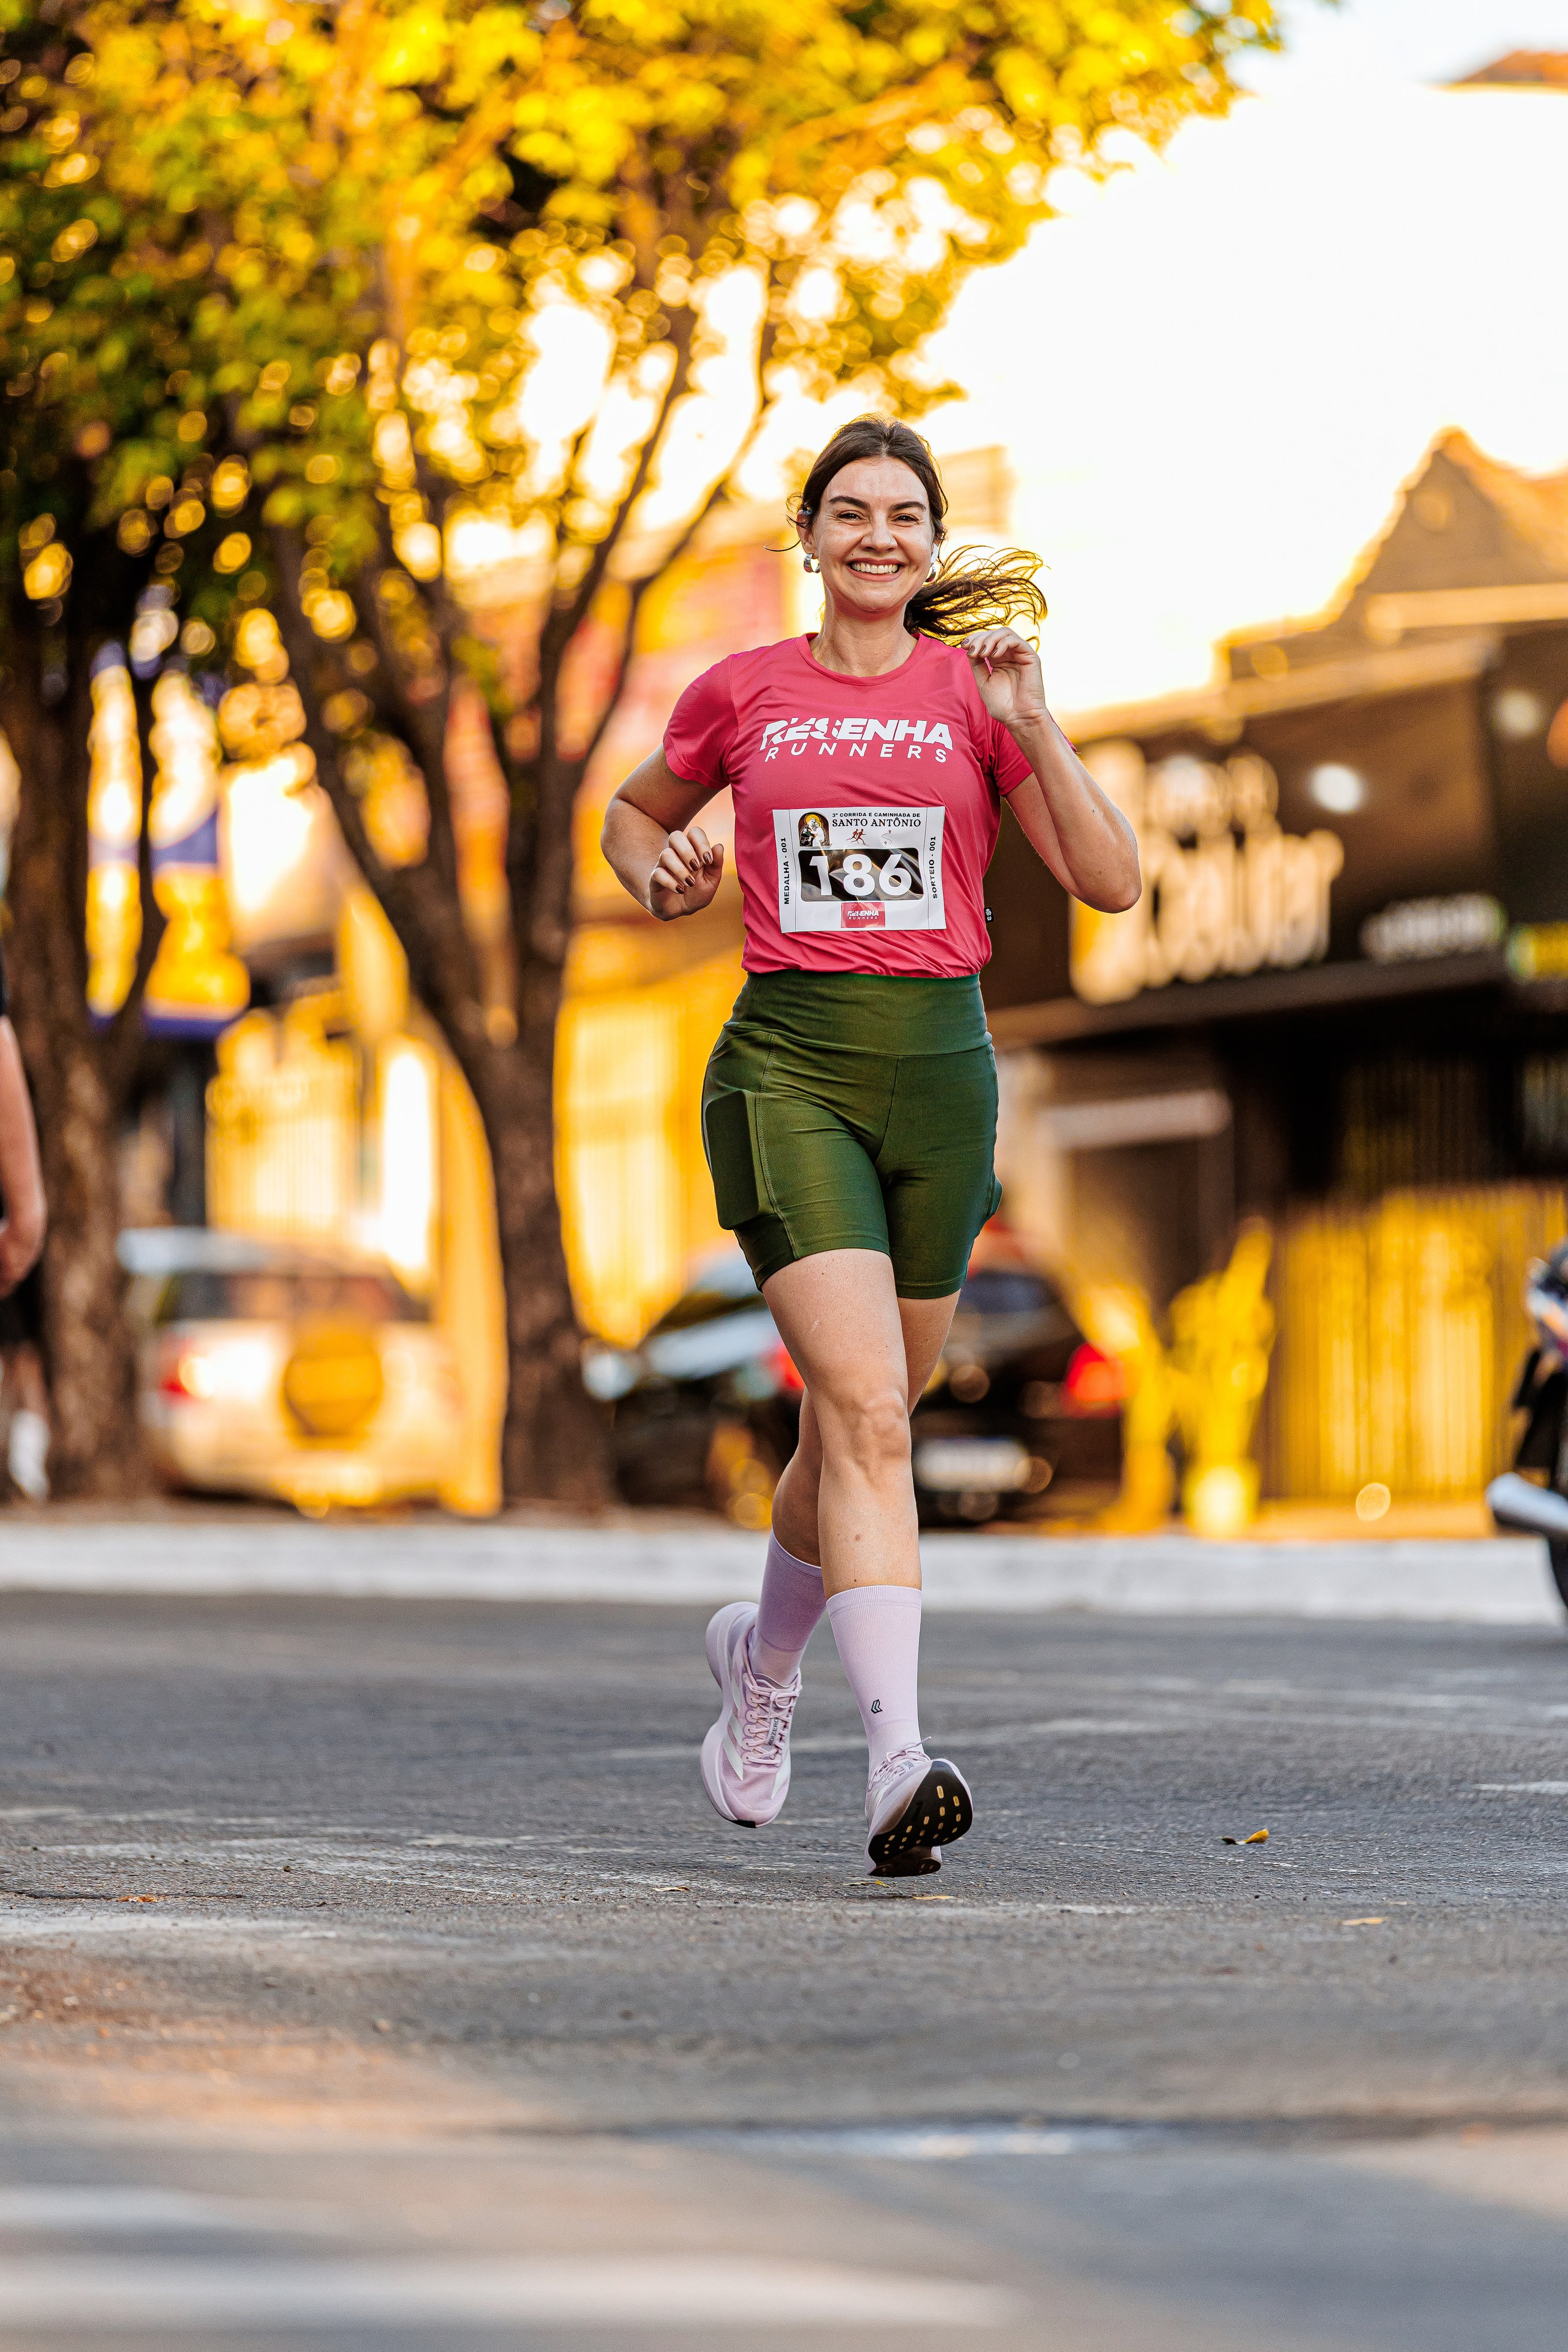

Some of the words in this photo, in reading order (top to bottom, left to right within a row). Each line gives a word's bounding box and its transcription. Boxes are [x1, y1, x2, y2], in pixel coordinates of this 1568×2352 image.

[760, 717, 954, 750] RESENHA
[764, 742, 947, 763] RUNNERS
[832, 818, 868, 827] SANTO
[870, 817, 921, 827] ANTÔNIO
[809, 853, 912, 896] 186
[929, 859, 938, 899] SORTEIO
